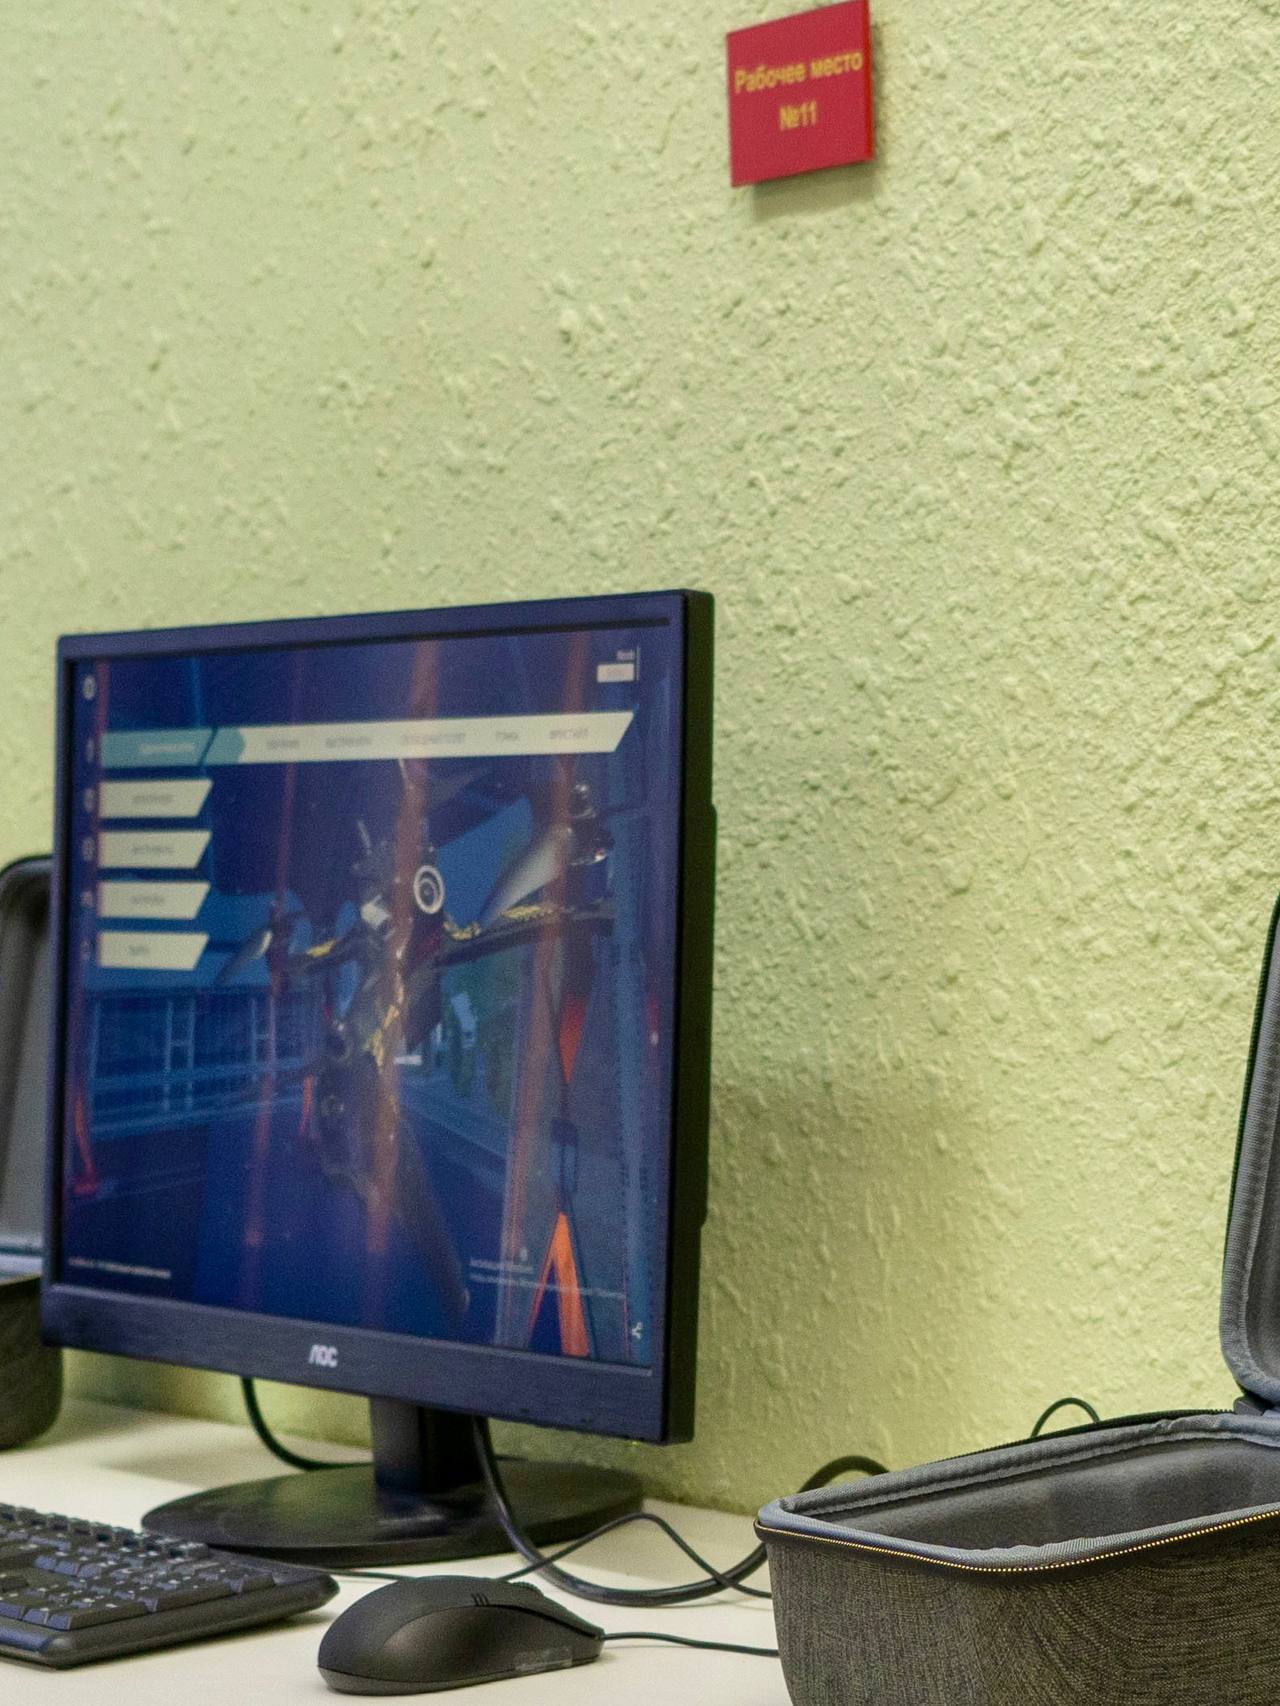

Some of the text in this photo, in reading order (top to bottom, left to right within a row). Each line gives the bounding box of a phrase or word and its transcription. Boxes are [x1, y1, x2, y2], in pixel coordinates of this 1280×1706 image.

[734, 52, 863, 94] Рабочее место
[779, 100, 817, 130] №11
[309, 1344, 338, 1368] AOC
